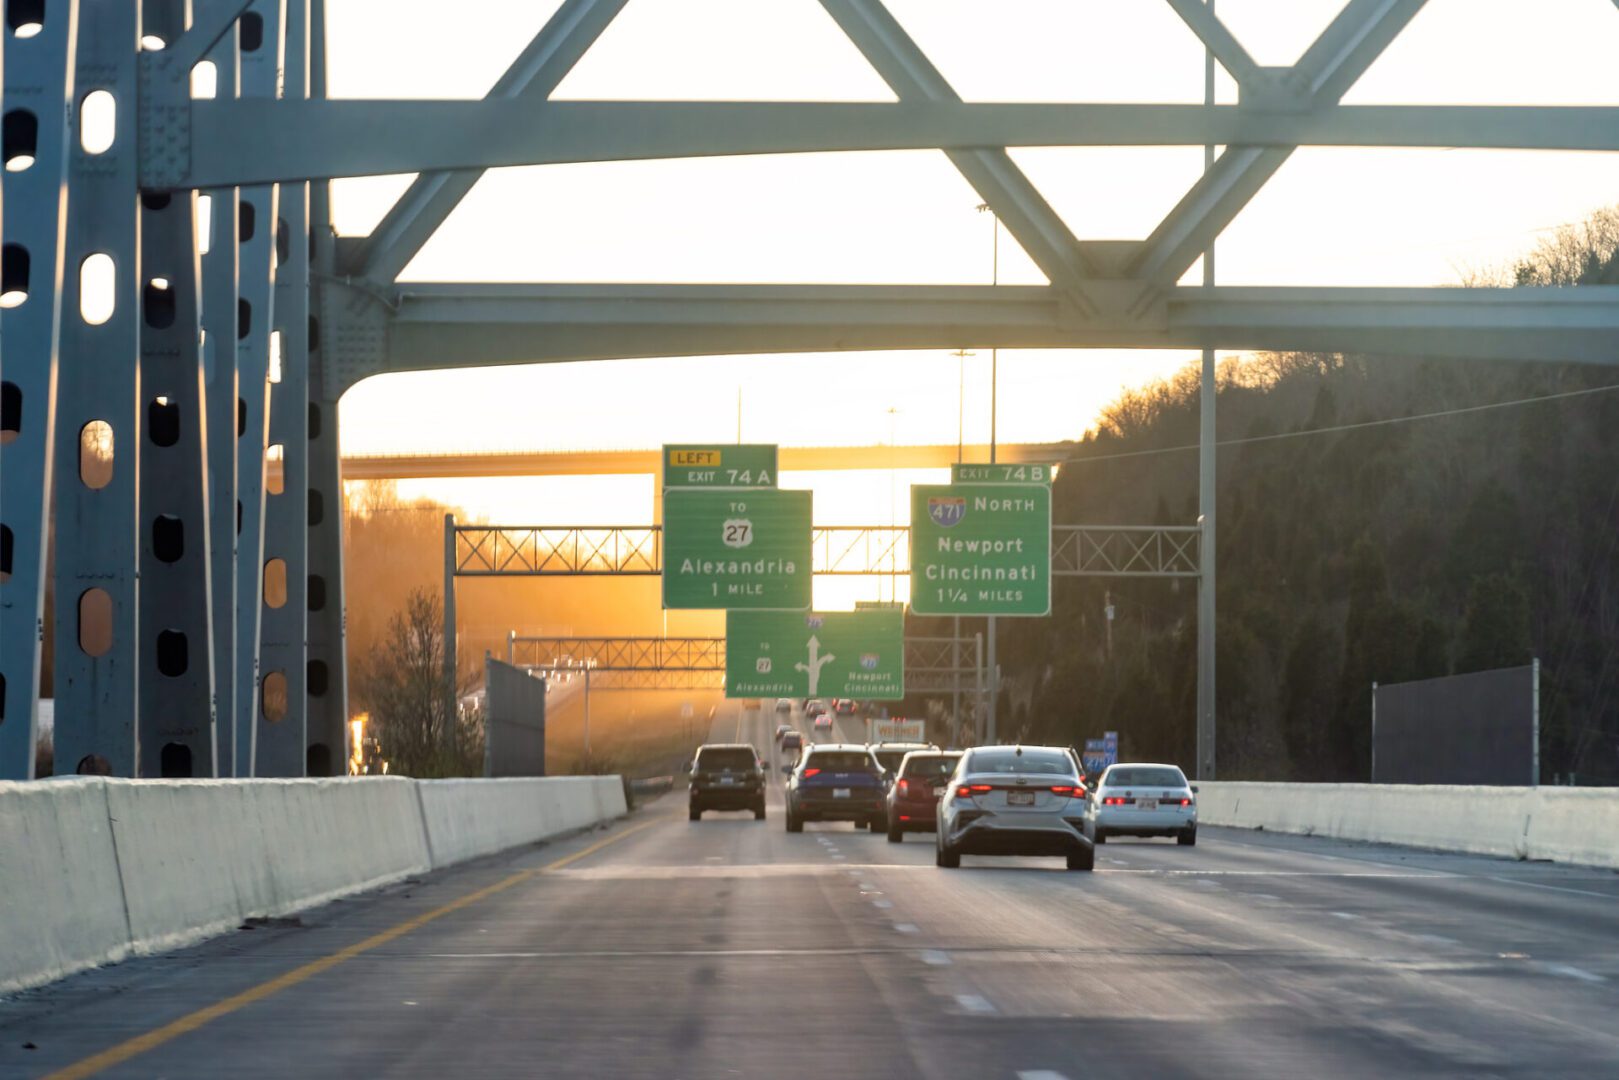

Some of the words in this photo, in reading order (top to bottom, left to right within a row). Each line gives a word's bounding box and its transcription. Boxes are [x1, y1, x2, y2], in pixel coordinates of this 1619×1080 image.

[677, 452, 714, 464] LEFT
[688, 471, 715, 482] EXIT
[959, 468, 990, 479] EXIT
[729, 502, 747, 513] TO
[975, 497, 1035, 511] NORTH
[933, 504, 960, 519] 471
[726, 525, 749, 542] 27
[937, 537, 1024, 555] Newport
[680, 558, 796, 574] Alexandria
[925, 564, 1036, 580] Cincinnati
[711, 582, 718, 597] 1
[728, 584, 764, 595] MILE
[979, 590, 1023, 601] MILES
[848, 671, 891, 682] Newport
[736, 682, 794, 692] Alexandria
[844, 682, 900, 693] Cincinnati
